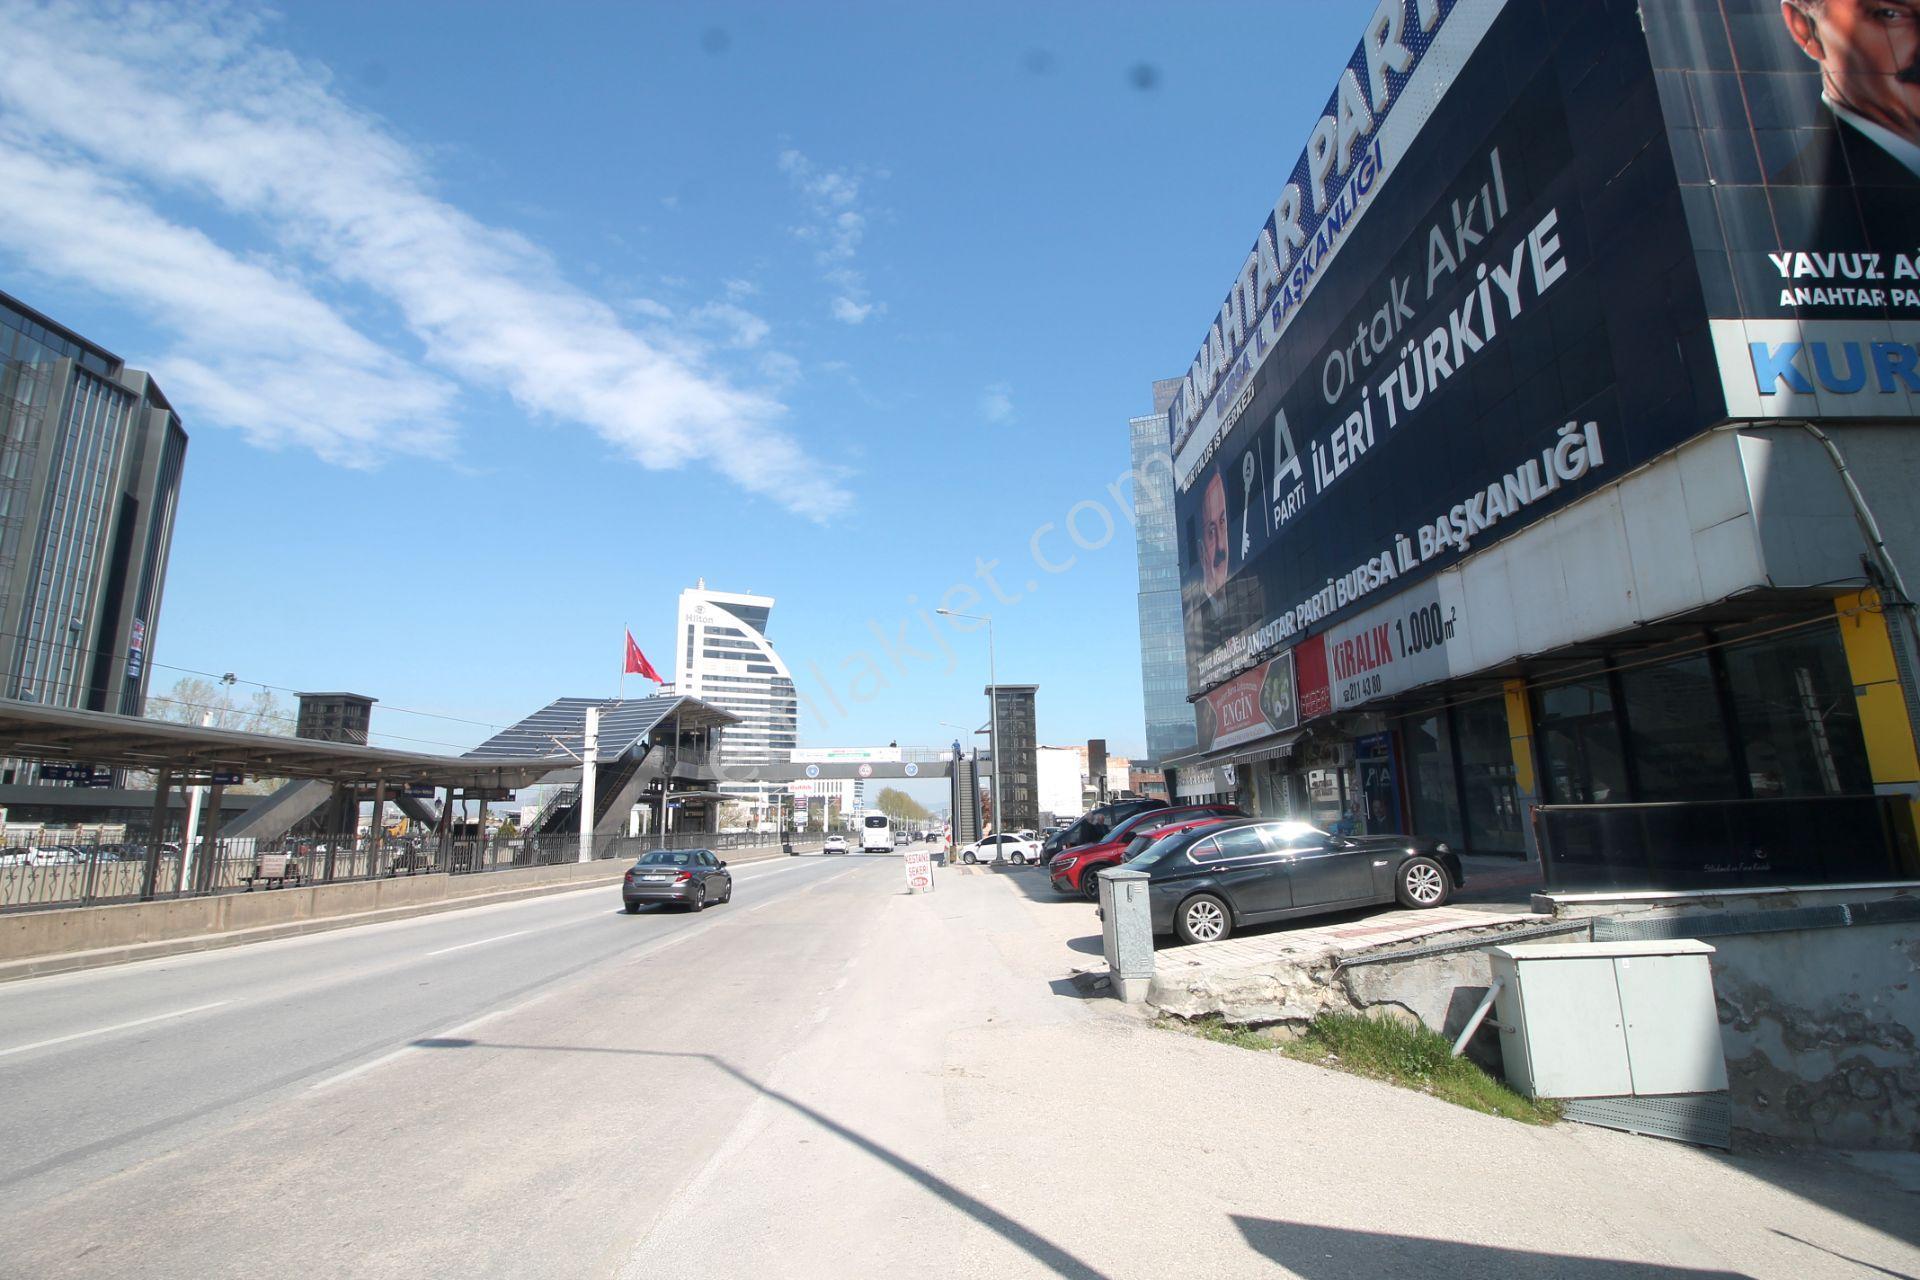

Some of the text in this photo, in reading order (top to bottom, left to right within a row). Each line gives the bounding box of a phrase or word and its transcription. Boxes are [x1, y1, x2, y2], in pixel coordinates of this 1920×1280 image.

[1182, 182, 1305, 432] ANAHTAR
[1307, 0, 1441, 214] PAR
[1322, 146, 1508, 404] Ortak Akıl
[1768, 247, 1920, 280] YAVUZ A
[1779, 287, 1920, 307] ANAHTAR PA
[1311, 208, 1568, 495] İLERİ TÜRKİYE
[1748, 341, 1920, 397] KUR
[1220, 381, 1256, 441] MERKEZİ
[1273, 407, 1303, 503] A
[1273, 480, 1307, 530] PARTİ
[1246, 420, 1604, 658] ANAHTAR PARTİ BURSA İL BAŞKANLIĞI
[686, 613, 714, 624] Hilton
[1331, 622, 1393, 682] KİRALIK
[1396, 602, 1444, 658] 1.000
[1222, 692, 1254, 727] ENGİN
[1349, 674, 1381, 700] 211 43 80
